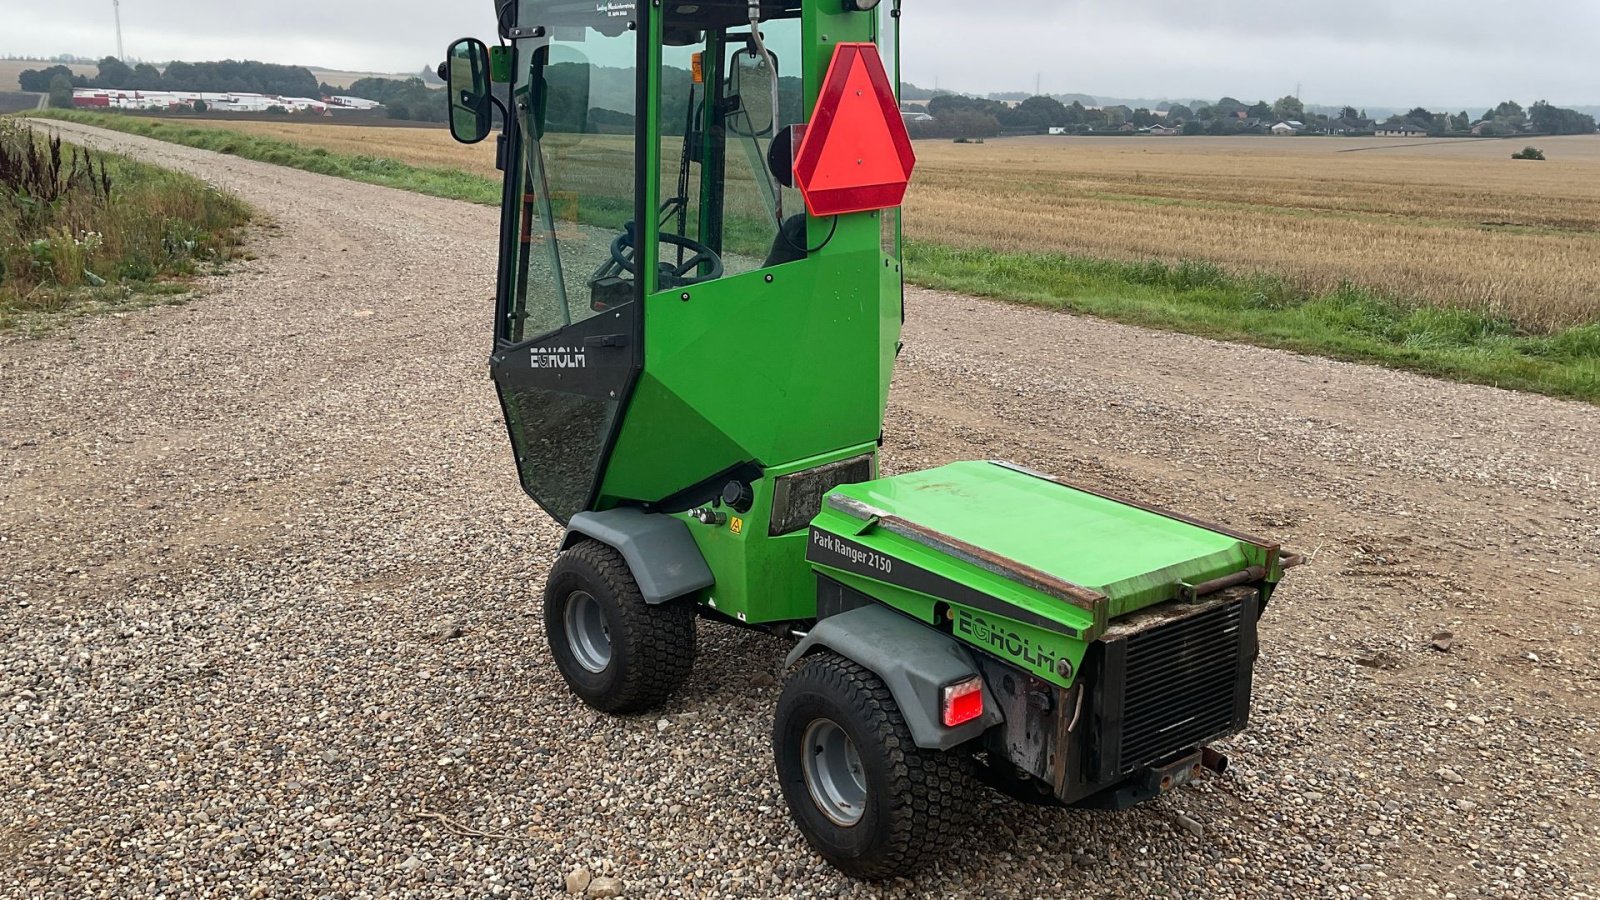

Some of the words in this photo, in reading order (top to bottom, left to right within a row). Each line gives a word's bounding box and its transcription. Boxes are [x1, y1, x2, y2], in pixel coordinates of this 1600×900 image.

[530, 346, 586, 368] EGHOLM
[813, 530, 833, 551] Park
[834, 538, 867, 563] Ranger
[868, 552, 892, 574] 2150
[959, 610, 1055, 673] EGHOLM
